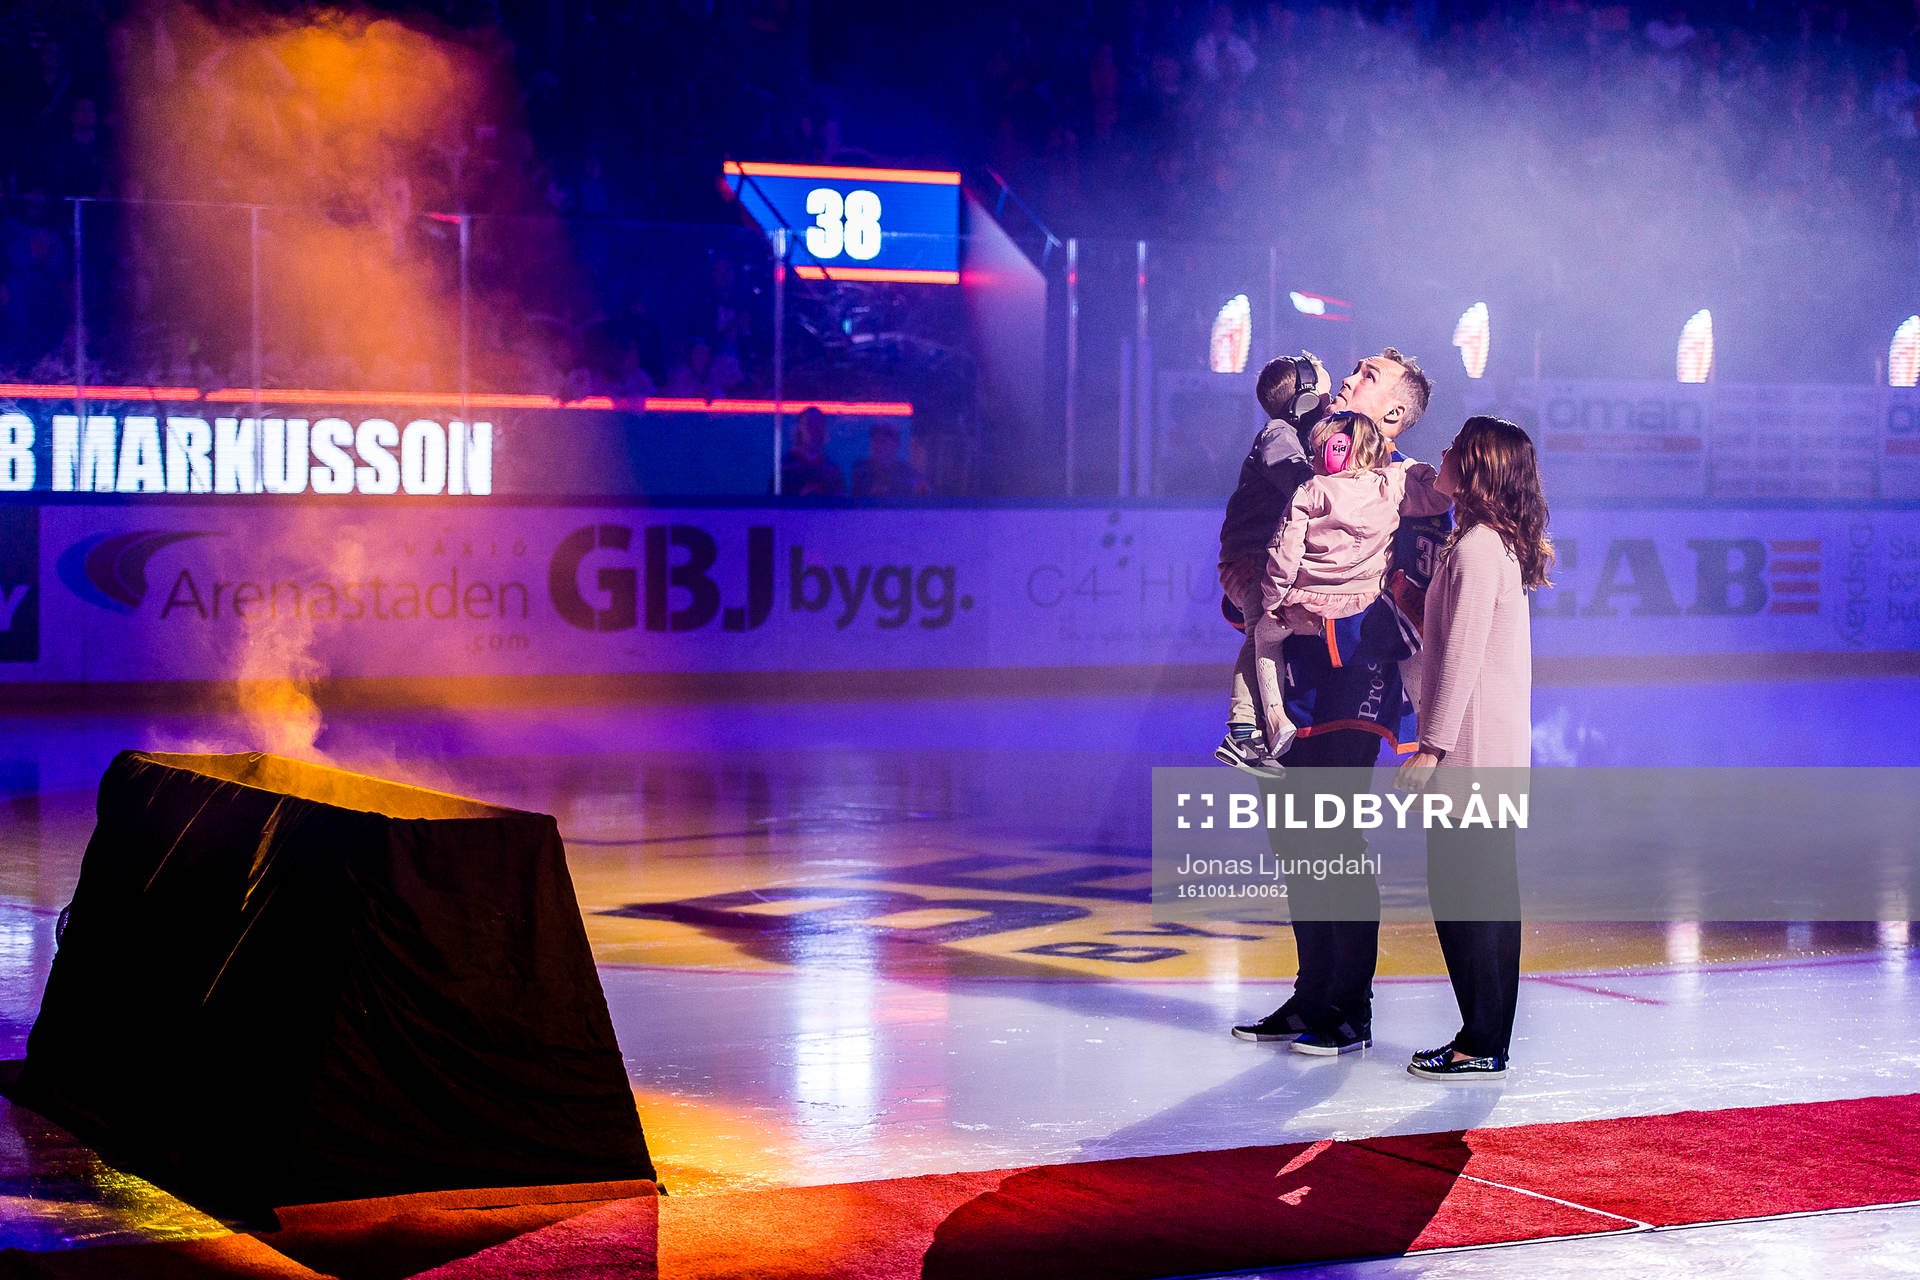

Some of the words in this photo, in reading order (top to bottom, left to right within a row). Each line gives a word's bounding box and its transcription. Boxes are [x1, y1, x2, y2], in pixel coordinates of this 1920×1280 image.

[805, 188, 882, 261] 38
[52, 414, 493, 496] MARKUSSON
[160, 566, 529, 621] Arenastaden
[547, 524, 775, 632] GBJ
[789, 545, 975, 630] bygg.
[1140, 562, 1219, 604] HU
